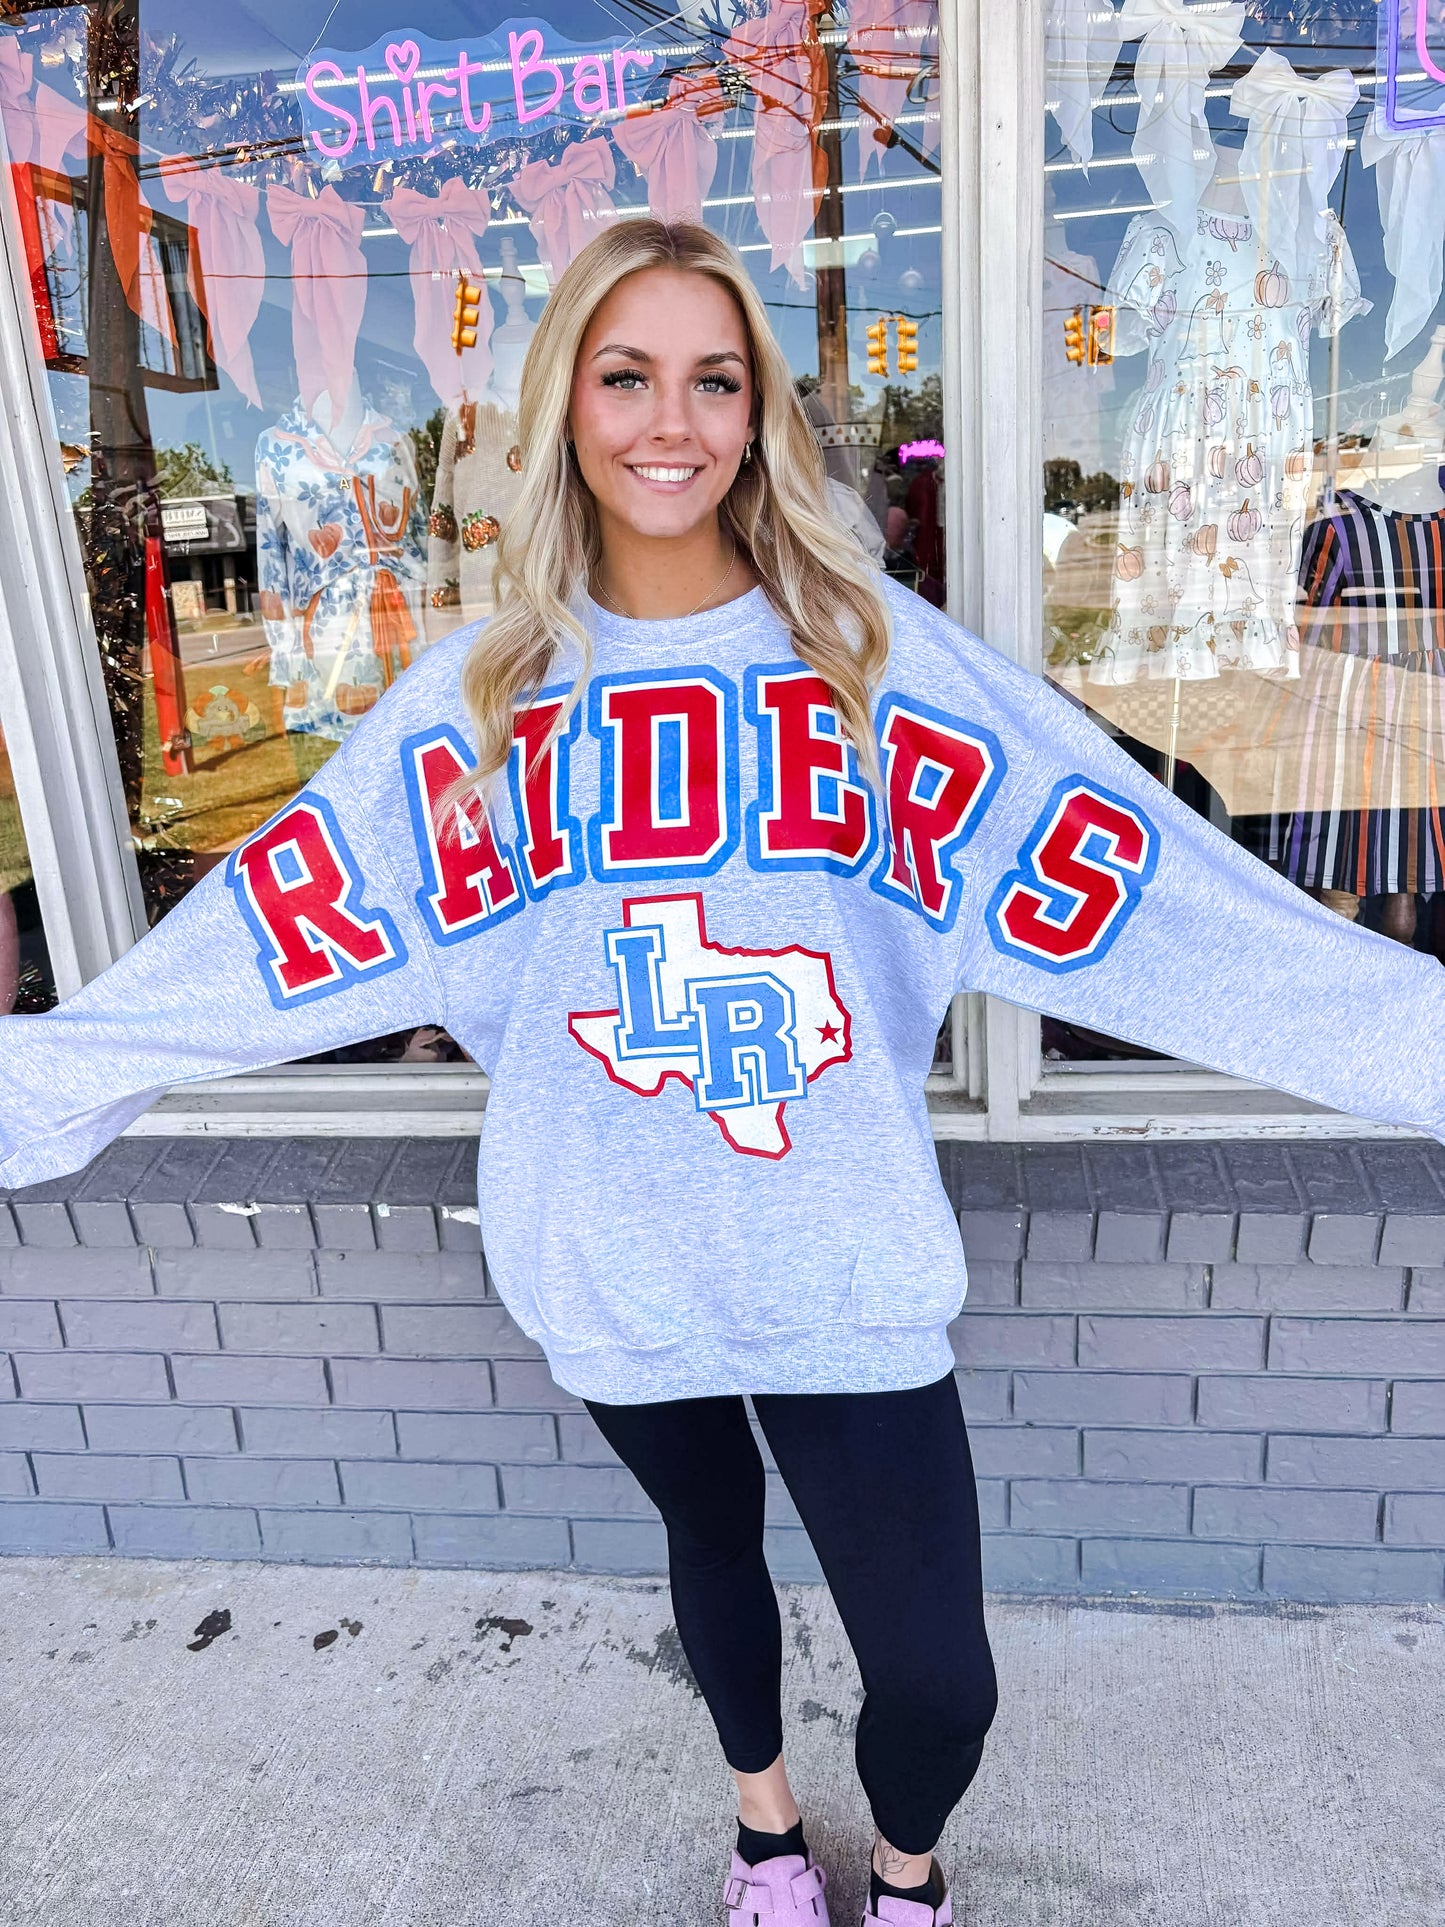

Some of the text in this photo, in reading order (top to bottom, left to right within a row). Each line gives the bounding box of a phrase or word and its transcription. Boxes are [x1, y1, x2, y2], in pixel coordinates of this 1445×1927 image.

[305, 30, 654, 157] Shirt Bar
[226, 660, 1161, 1009] RAIDERS
[603, 924, 808, 1113] LR
